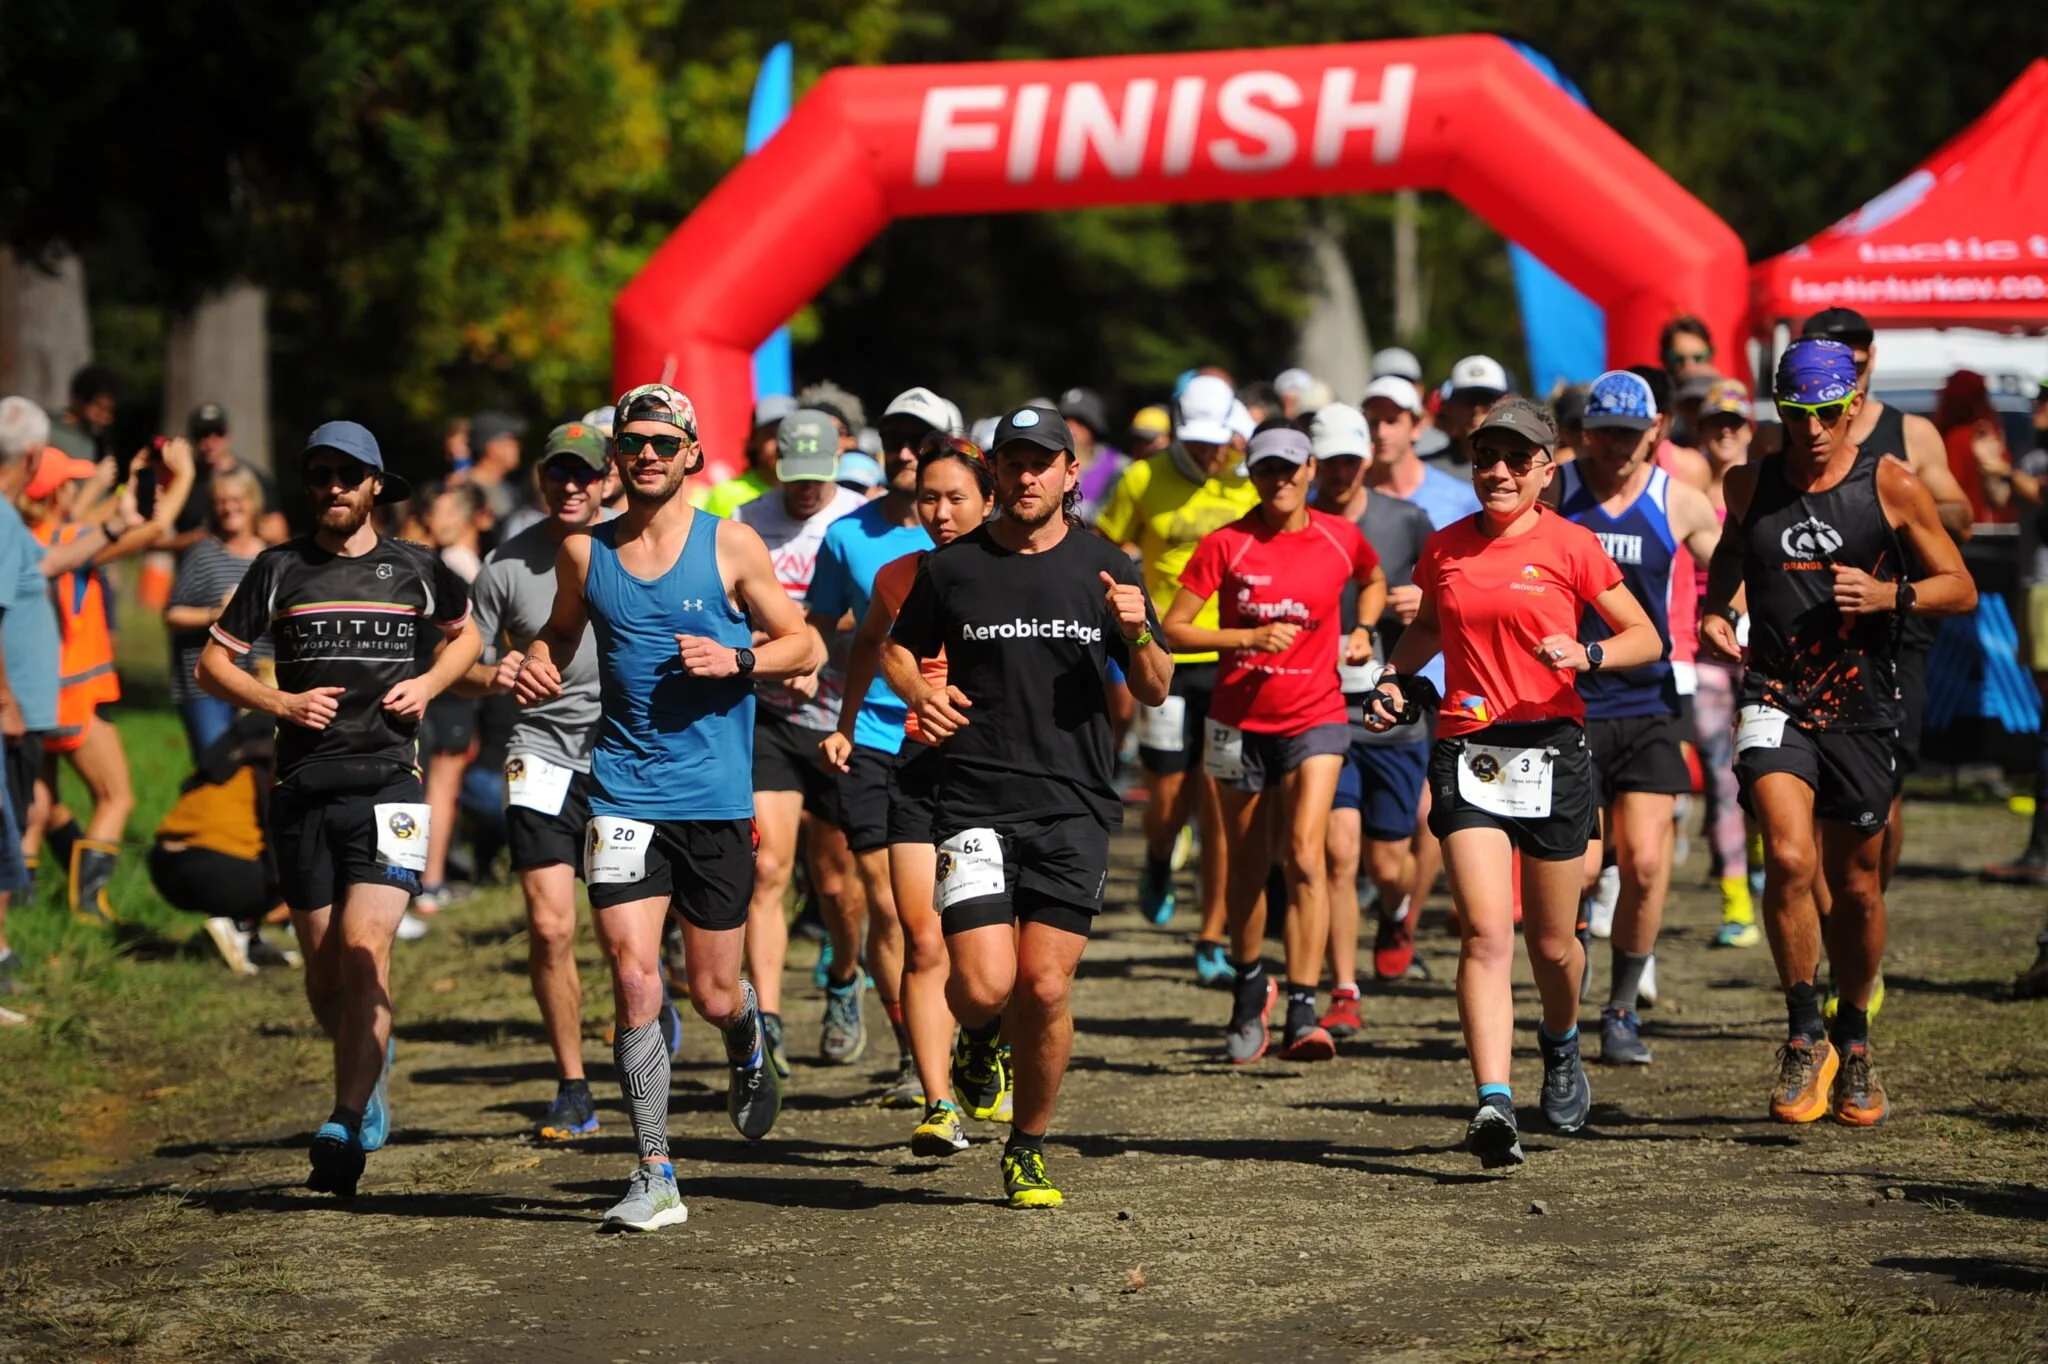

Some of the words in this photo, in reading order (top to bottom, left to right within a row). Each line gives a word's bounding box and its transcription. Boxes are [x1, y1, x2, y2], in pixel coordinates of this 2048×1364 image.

[913, 63, 1417, 187] FINISH
[284, 620, 414, 638] ALTITUDE
[962, 618, 1101, 645] AerobicEdge
[1213, 728, 1230, 742] 27
[1520, 758, 1531, 773] 3
[612, 827, 636, 841] 20
[963, 838, 983, 854] 62
